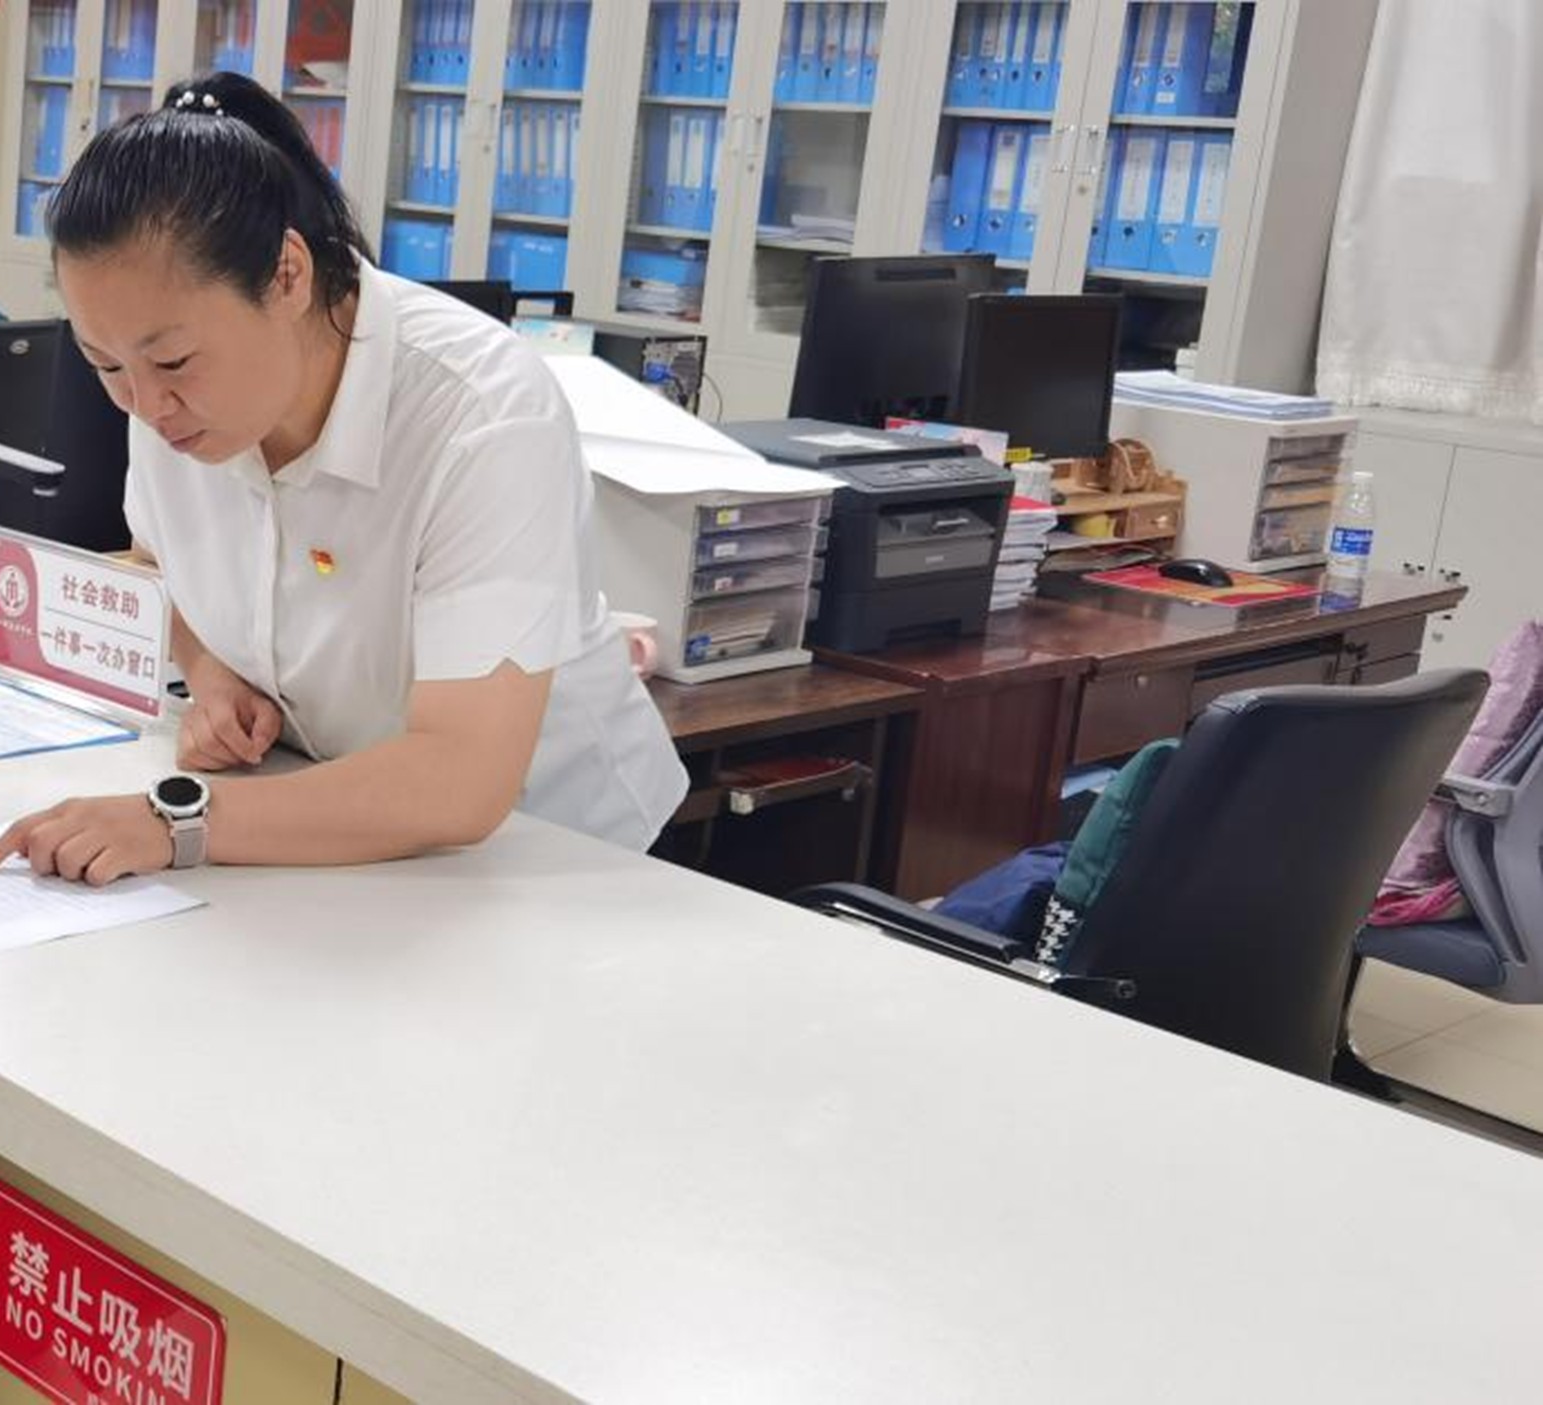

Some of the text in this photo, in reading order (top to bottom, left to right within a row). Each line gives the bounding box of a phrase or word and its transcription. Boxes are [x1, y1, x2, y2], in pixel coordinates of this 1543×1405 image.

[62, 573, 140, 620] 社会救助
[41, 626, 156, 681] 一件事一次办窗口
[6, 1295, 43, 1341] NO
[9, 1231, 195, 1399] 禁止吸烟
